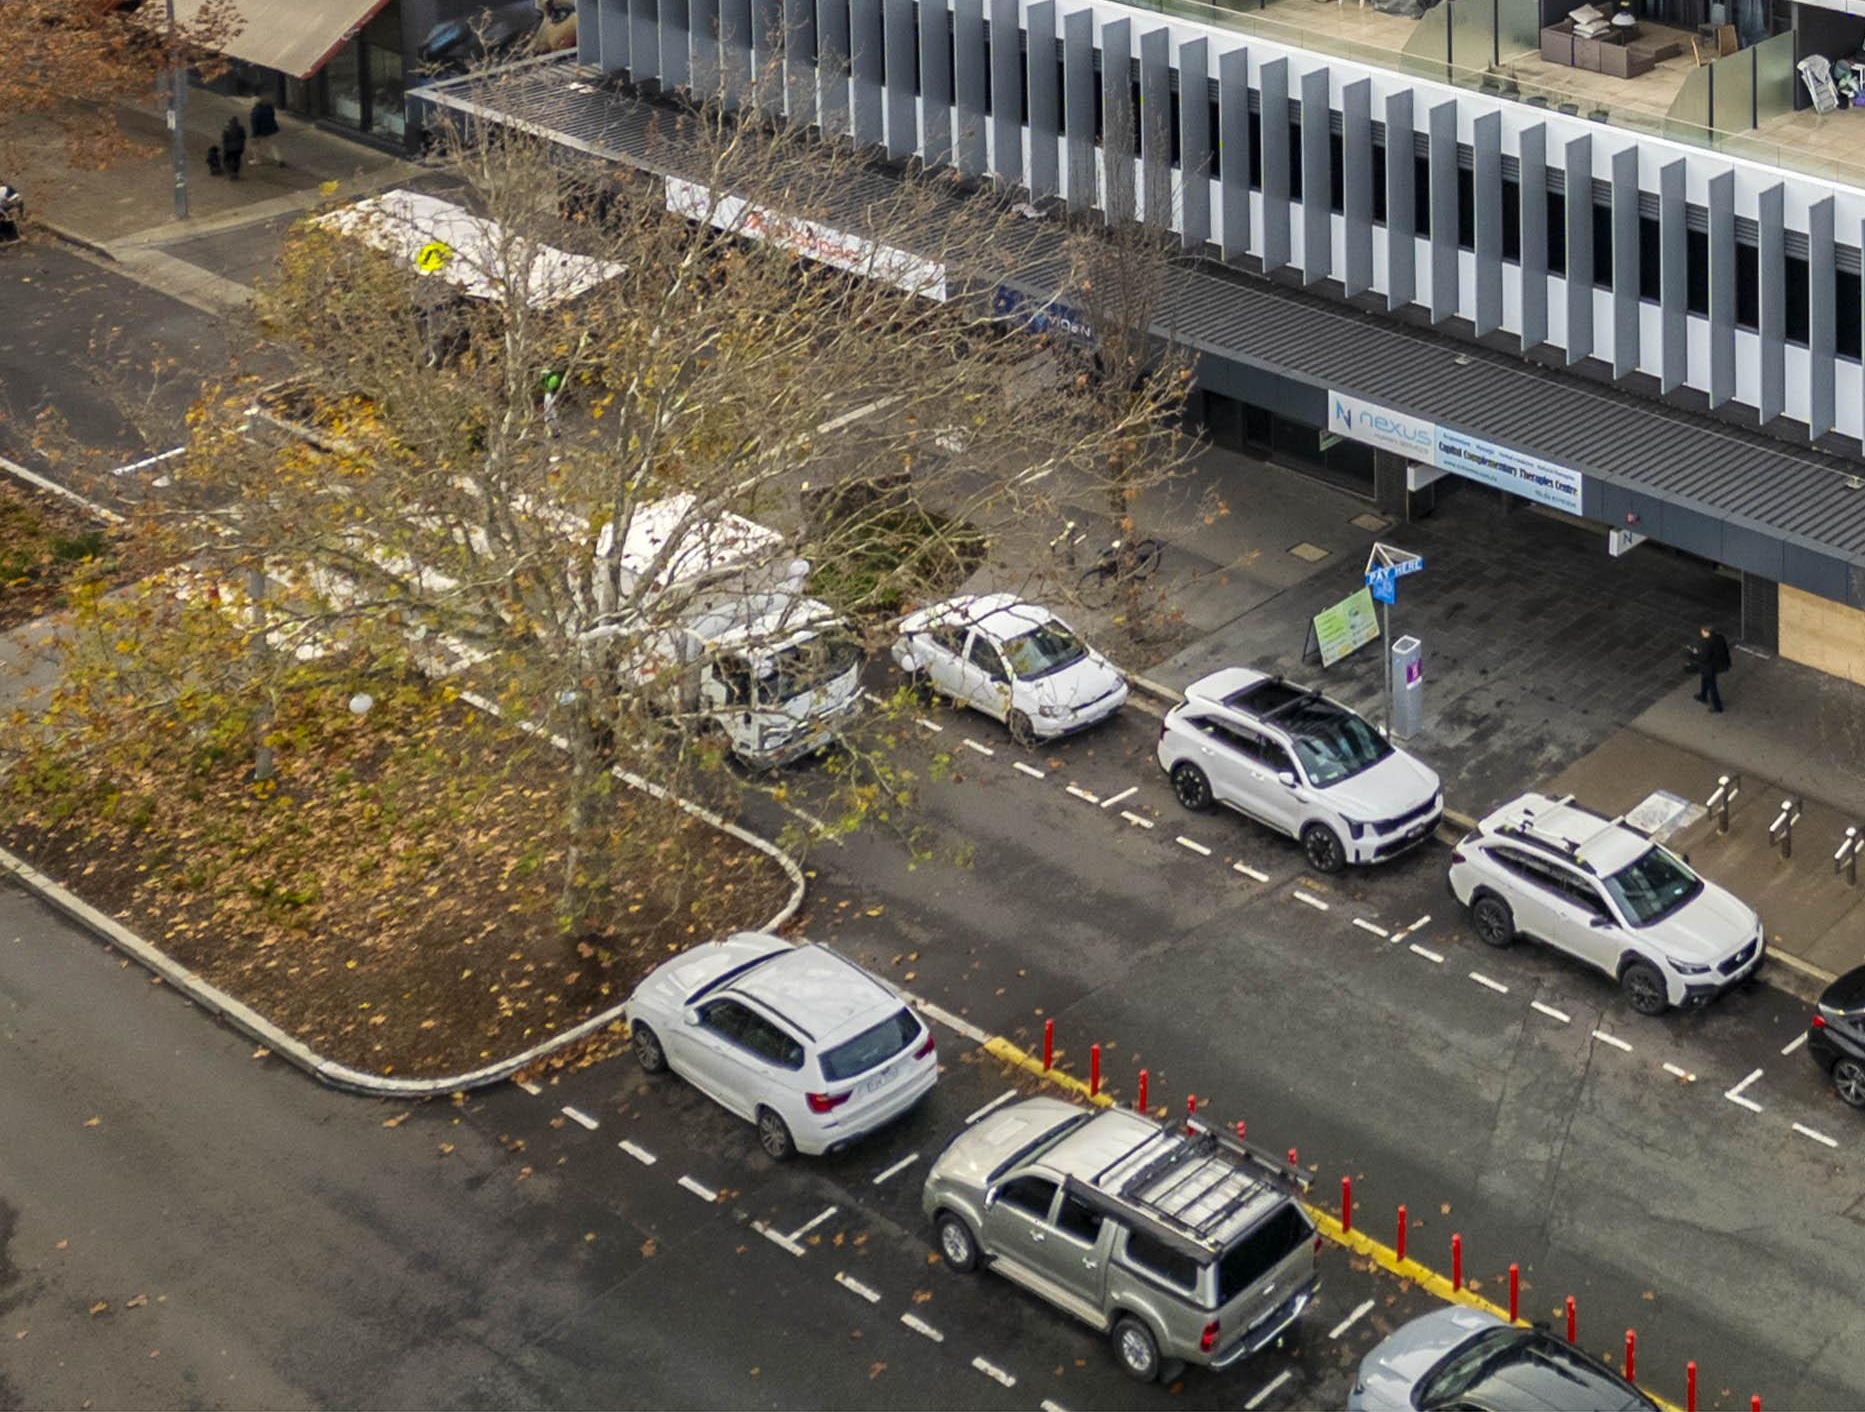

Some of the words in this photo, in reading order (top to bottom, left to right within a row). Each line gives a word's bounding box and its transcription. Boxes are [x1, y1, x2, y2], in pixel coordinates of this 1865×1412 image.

[1360, 410, 1432, 446] nexus
[1438, 441, 1462, 457] Capital
[1519, 468, 1554, 489] Therapies
[1369, 566, 1390, 586] PAY
